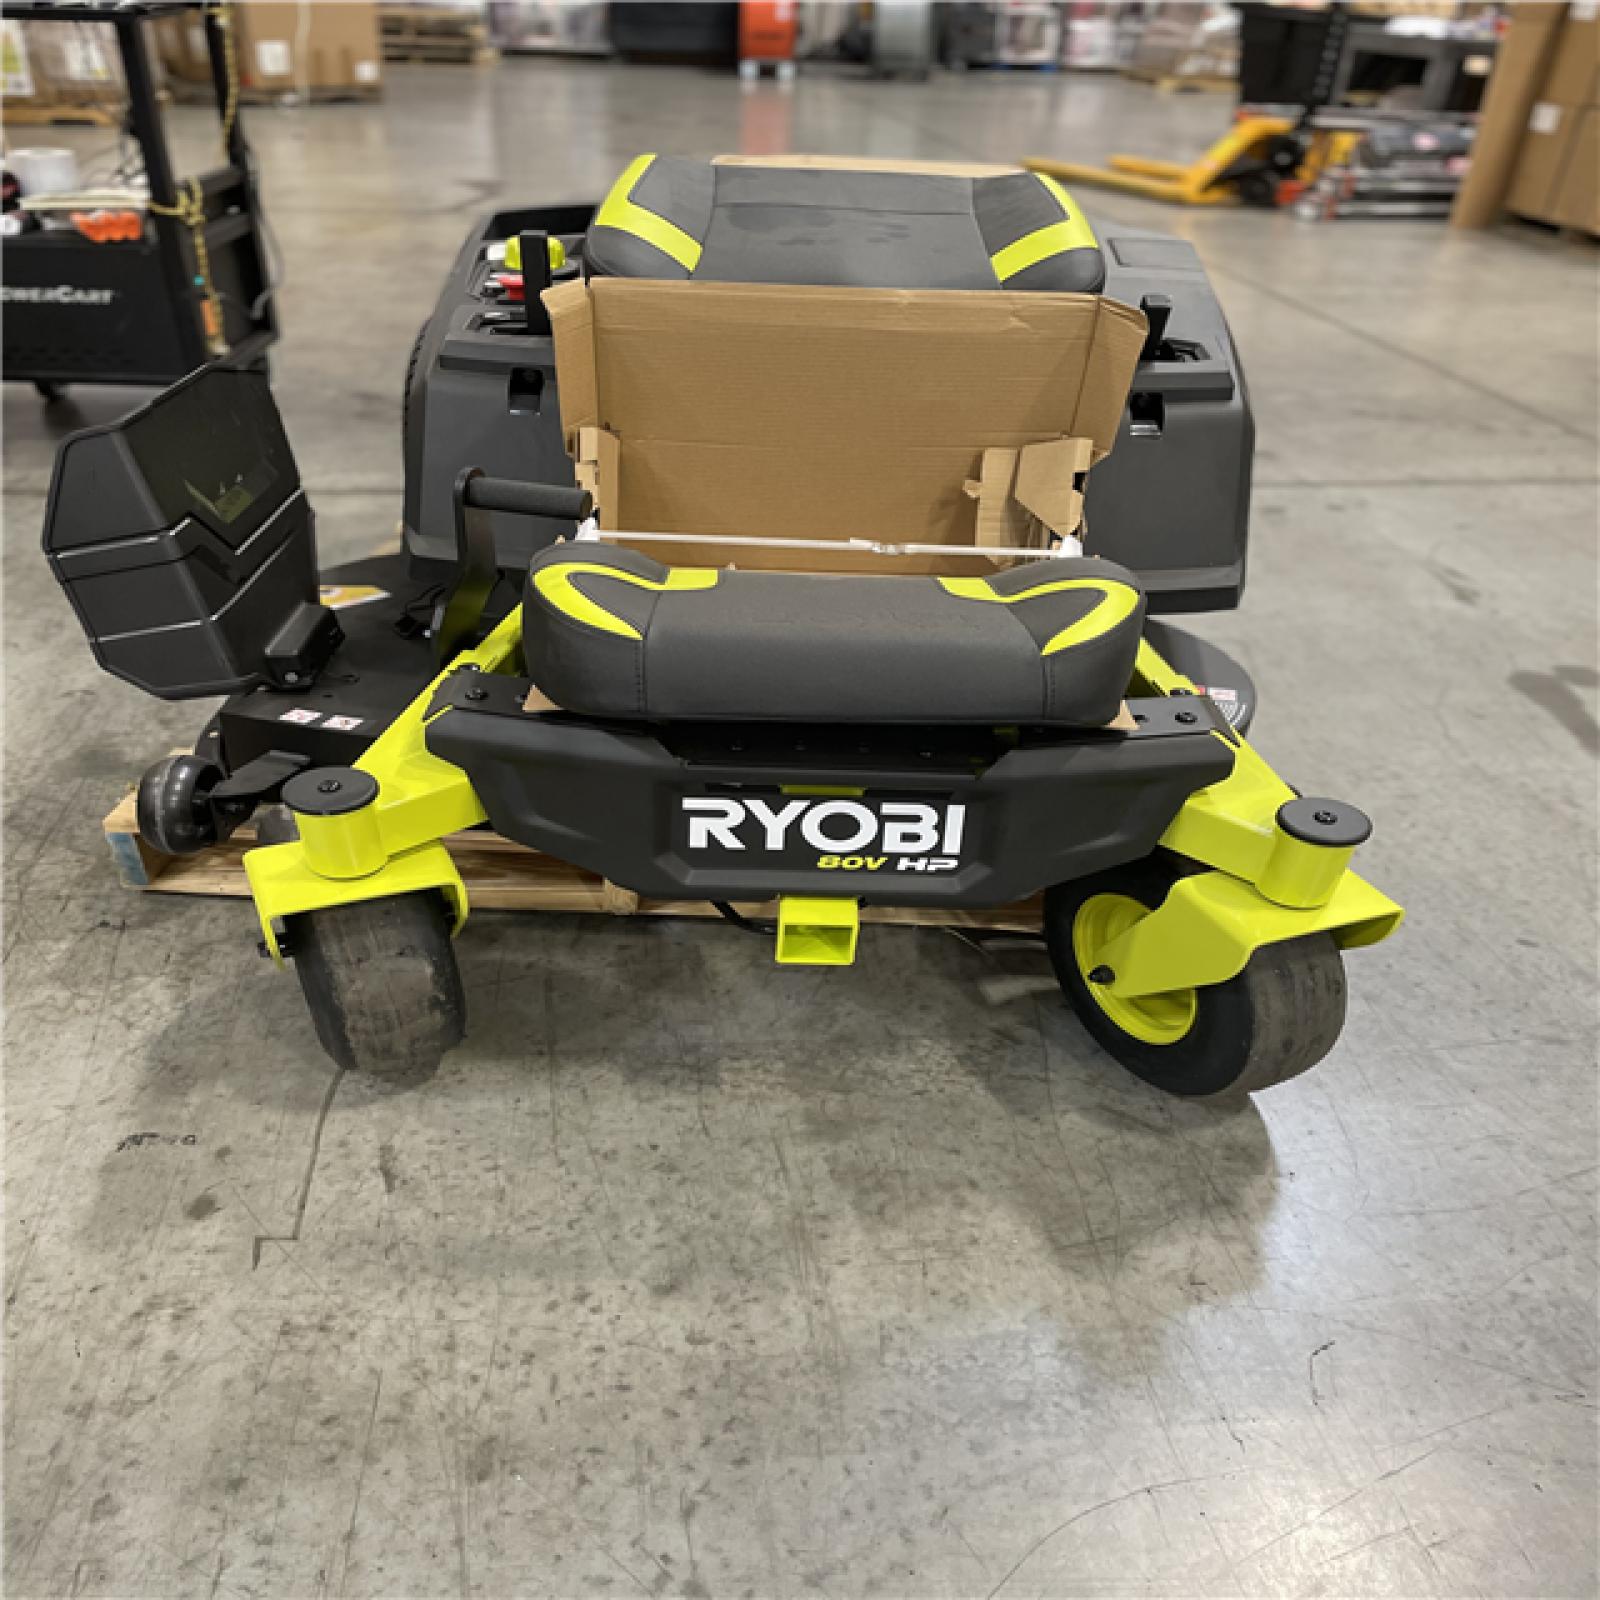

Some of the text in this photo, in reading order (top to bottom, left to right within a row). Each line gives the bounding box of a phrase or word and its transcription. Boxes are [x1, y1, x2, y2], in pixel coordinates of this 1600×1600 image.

[682, 797, 965, 855] RYOBI
[817, 855, 959, 871] 80V HP
